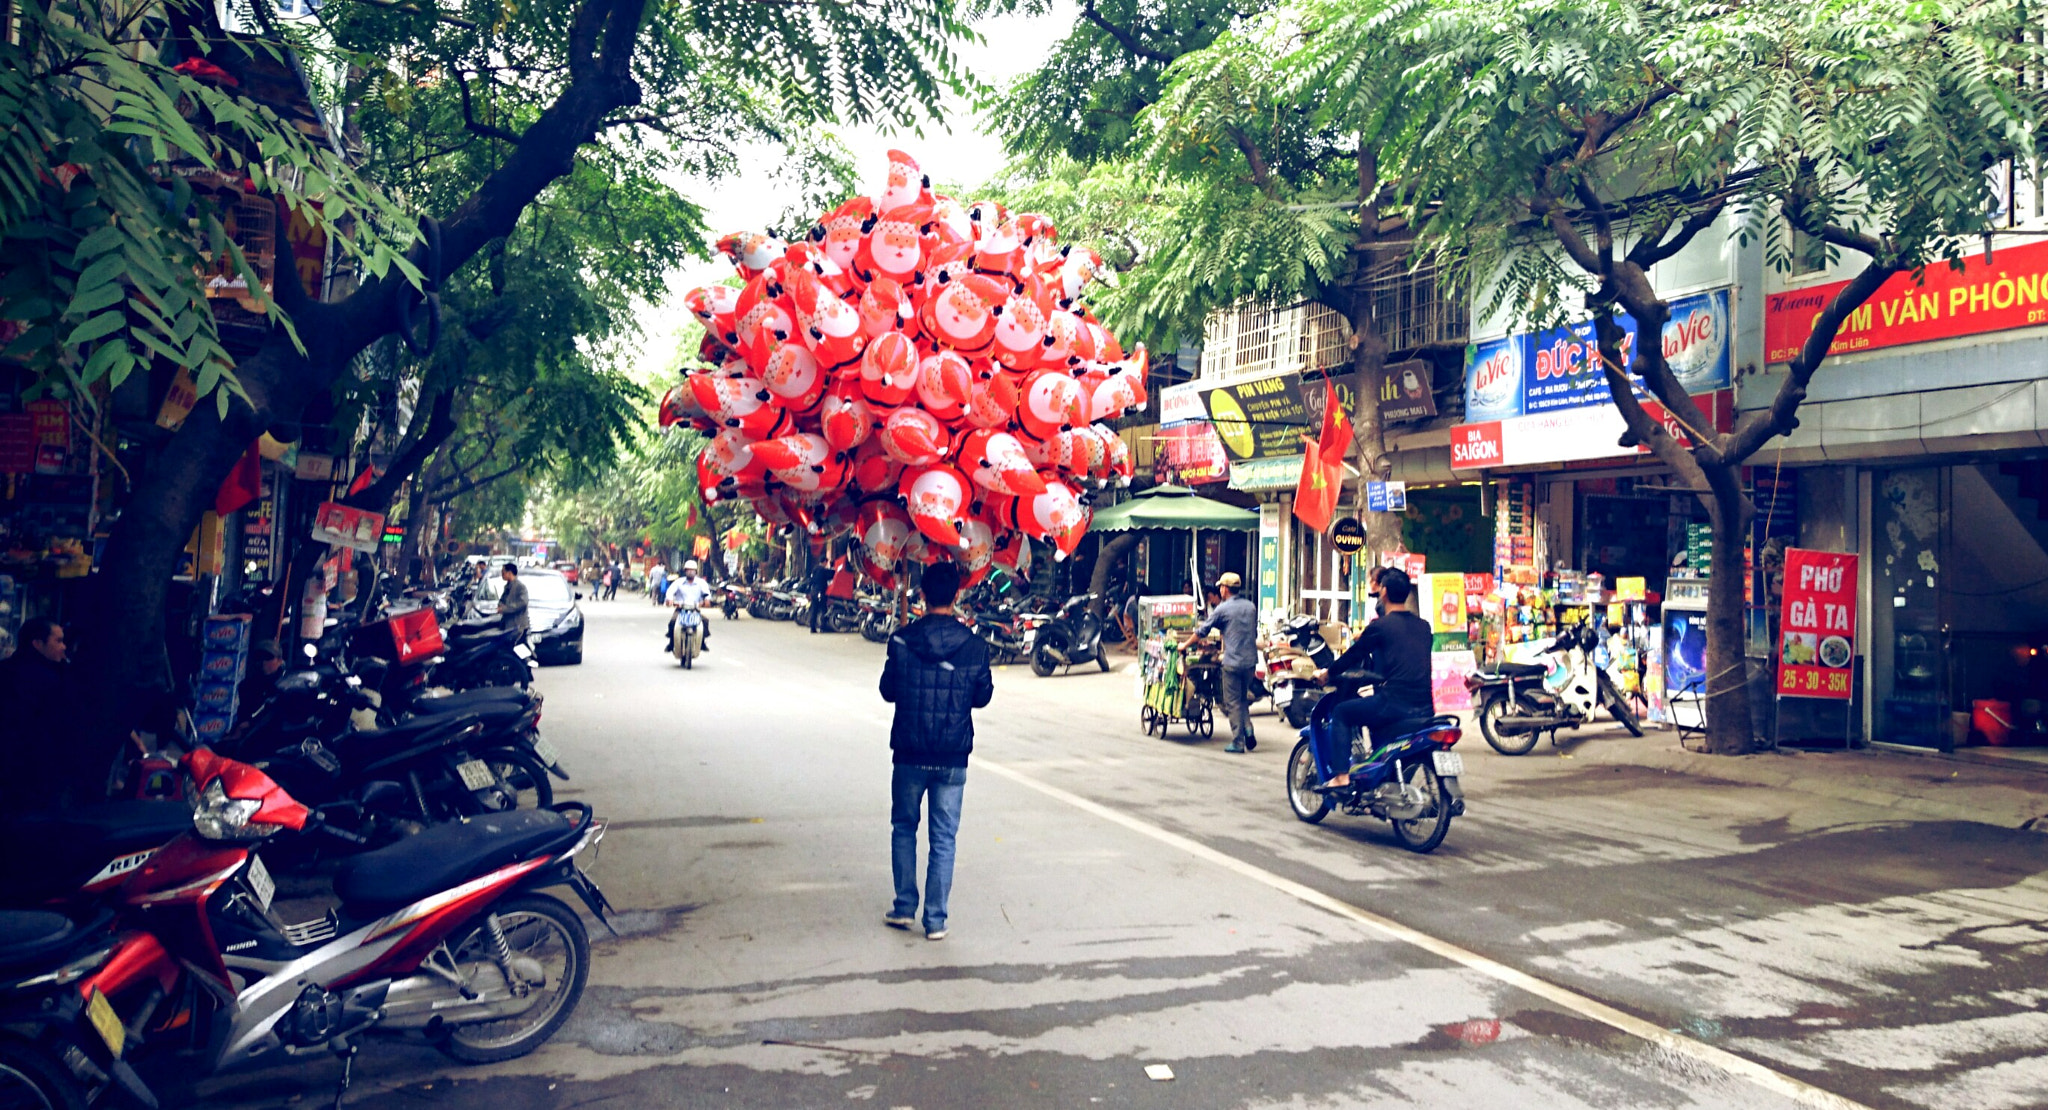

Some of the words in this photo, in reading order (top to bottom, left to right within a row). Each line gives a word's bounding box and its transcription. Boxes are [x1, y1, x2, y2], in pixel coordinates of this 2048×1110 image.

[1880, 290, 1940, 328] VĂN
[1831, 340, 1848, 352] Kim
[1849, 337, 1869, 349] Liên
[1536, 338, 1582, 381] ĐỨC
[1586, 331, 1635, 373] HY
[1236, 385, 1255, 399] PIN
[1468, 430, 1481, 442] BIA
[1454, 440, 1497, 461] SAIGON
[1800, 557, 1844, 593] PHỞ
[1790, 597, 1817, 628] GÀ
[1825, 604, 1848, 630] TA
[1783, 669, 1797, 690] 25
[1806, 671, 1819, 690] 30
[1828, 673, 1848, 692] 35K
[226, 940, 258, 952] HONDA
